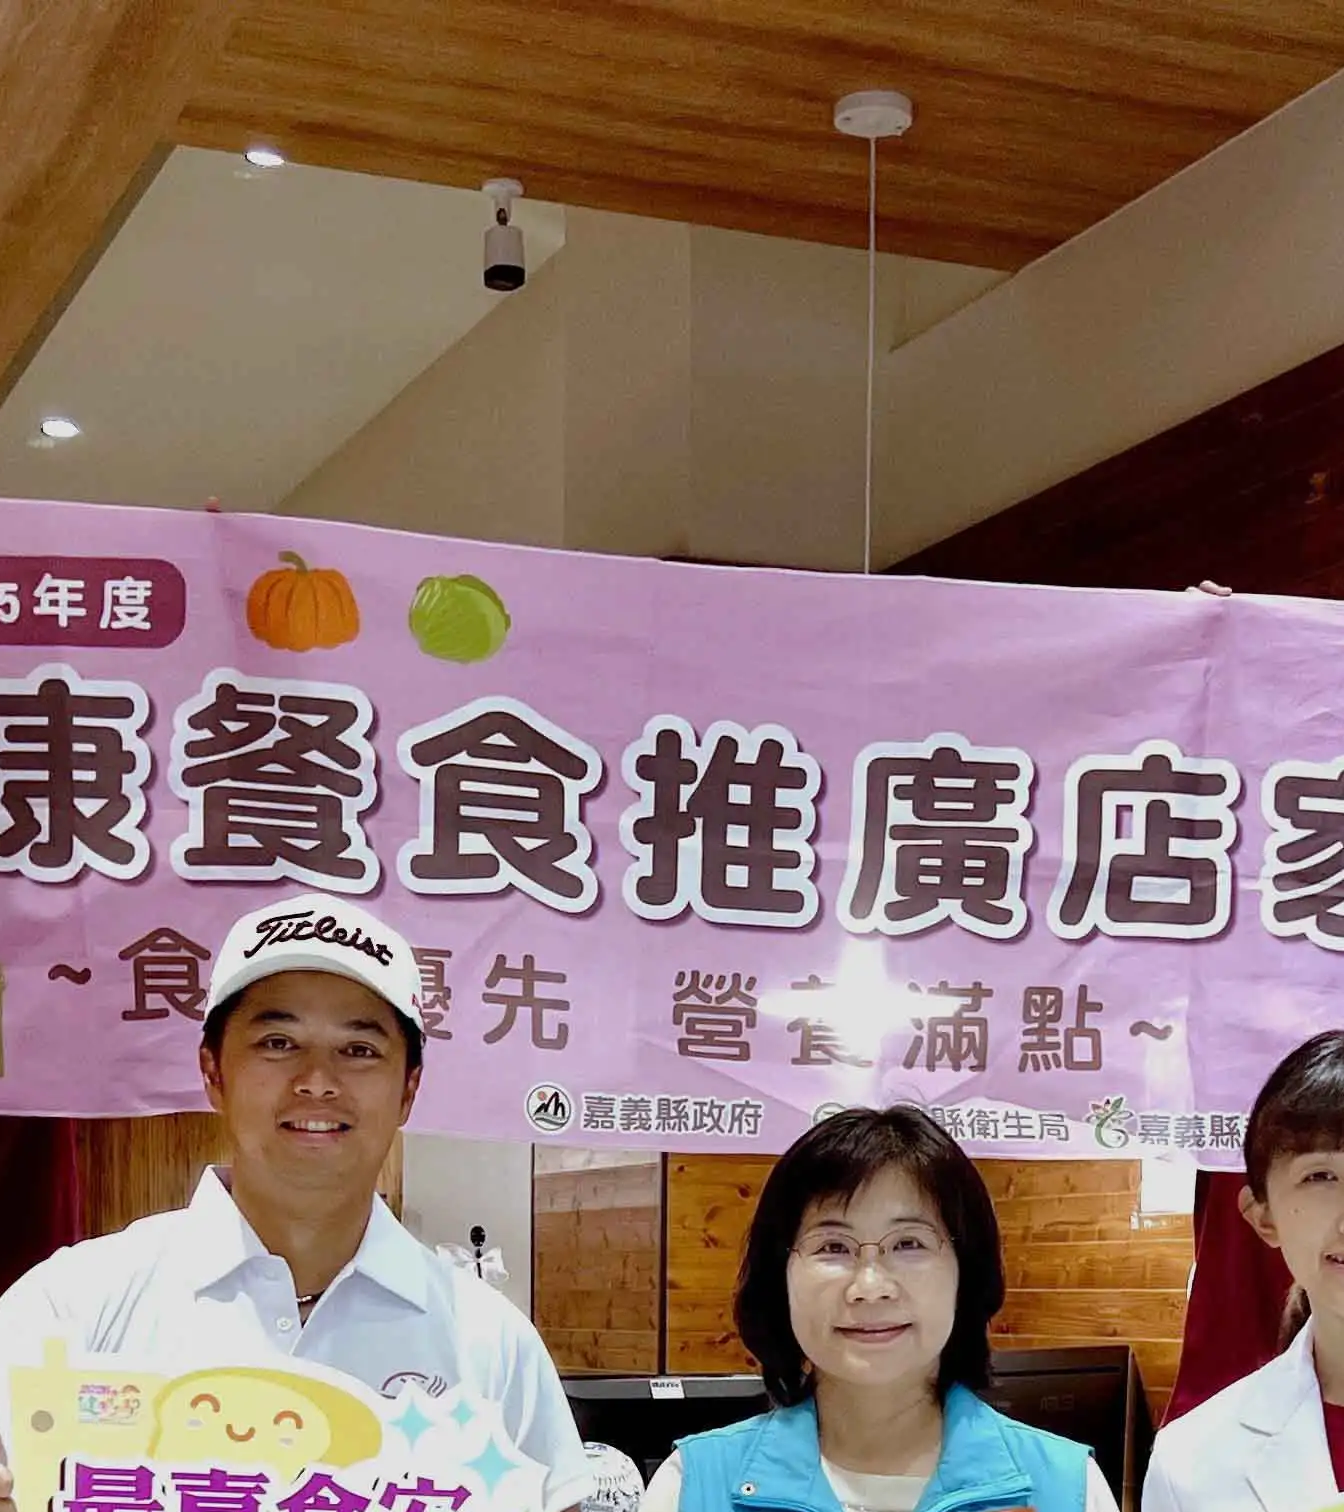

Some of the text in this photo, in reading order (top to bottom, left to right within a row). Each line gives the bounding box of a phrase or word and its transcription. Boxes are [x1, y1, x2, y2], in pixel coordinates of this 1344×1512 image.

[244, 910, 394, 967] Titleist
[583, 1095, 763, 1135] 嘉義縣政府
[1137, 1113, 1246, 1149] 嘉義縣
